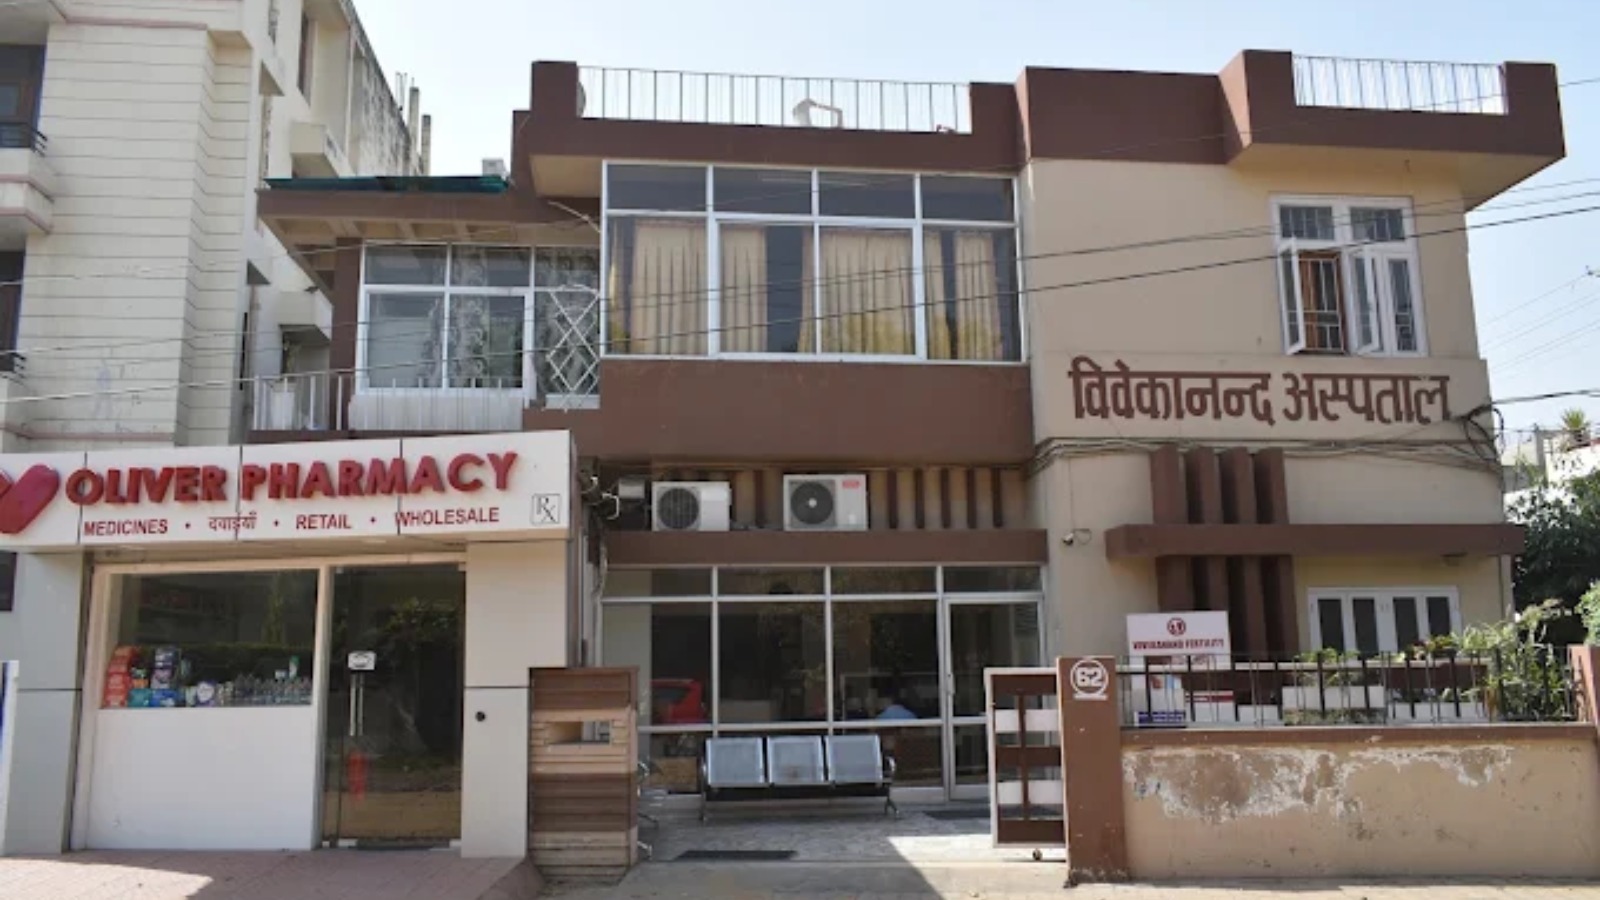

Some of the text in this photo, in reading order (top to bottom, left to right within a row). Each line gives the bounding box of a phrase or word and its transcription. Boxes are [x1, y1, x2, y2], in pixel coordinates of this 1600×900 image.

[1069, 356, 1450, 425] विवेकानन्द अस्पताल
[65, 452, 519, 506] OLIVER PHARMACY
[84, 518, 168, 536] MEDICINES
[296, 513, 352, 530] RETAIL
[395, 507, 500, 525] WHOLESALE
[1075, 667, 1102, 687] 62
